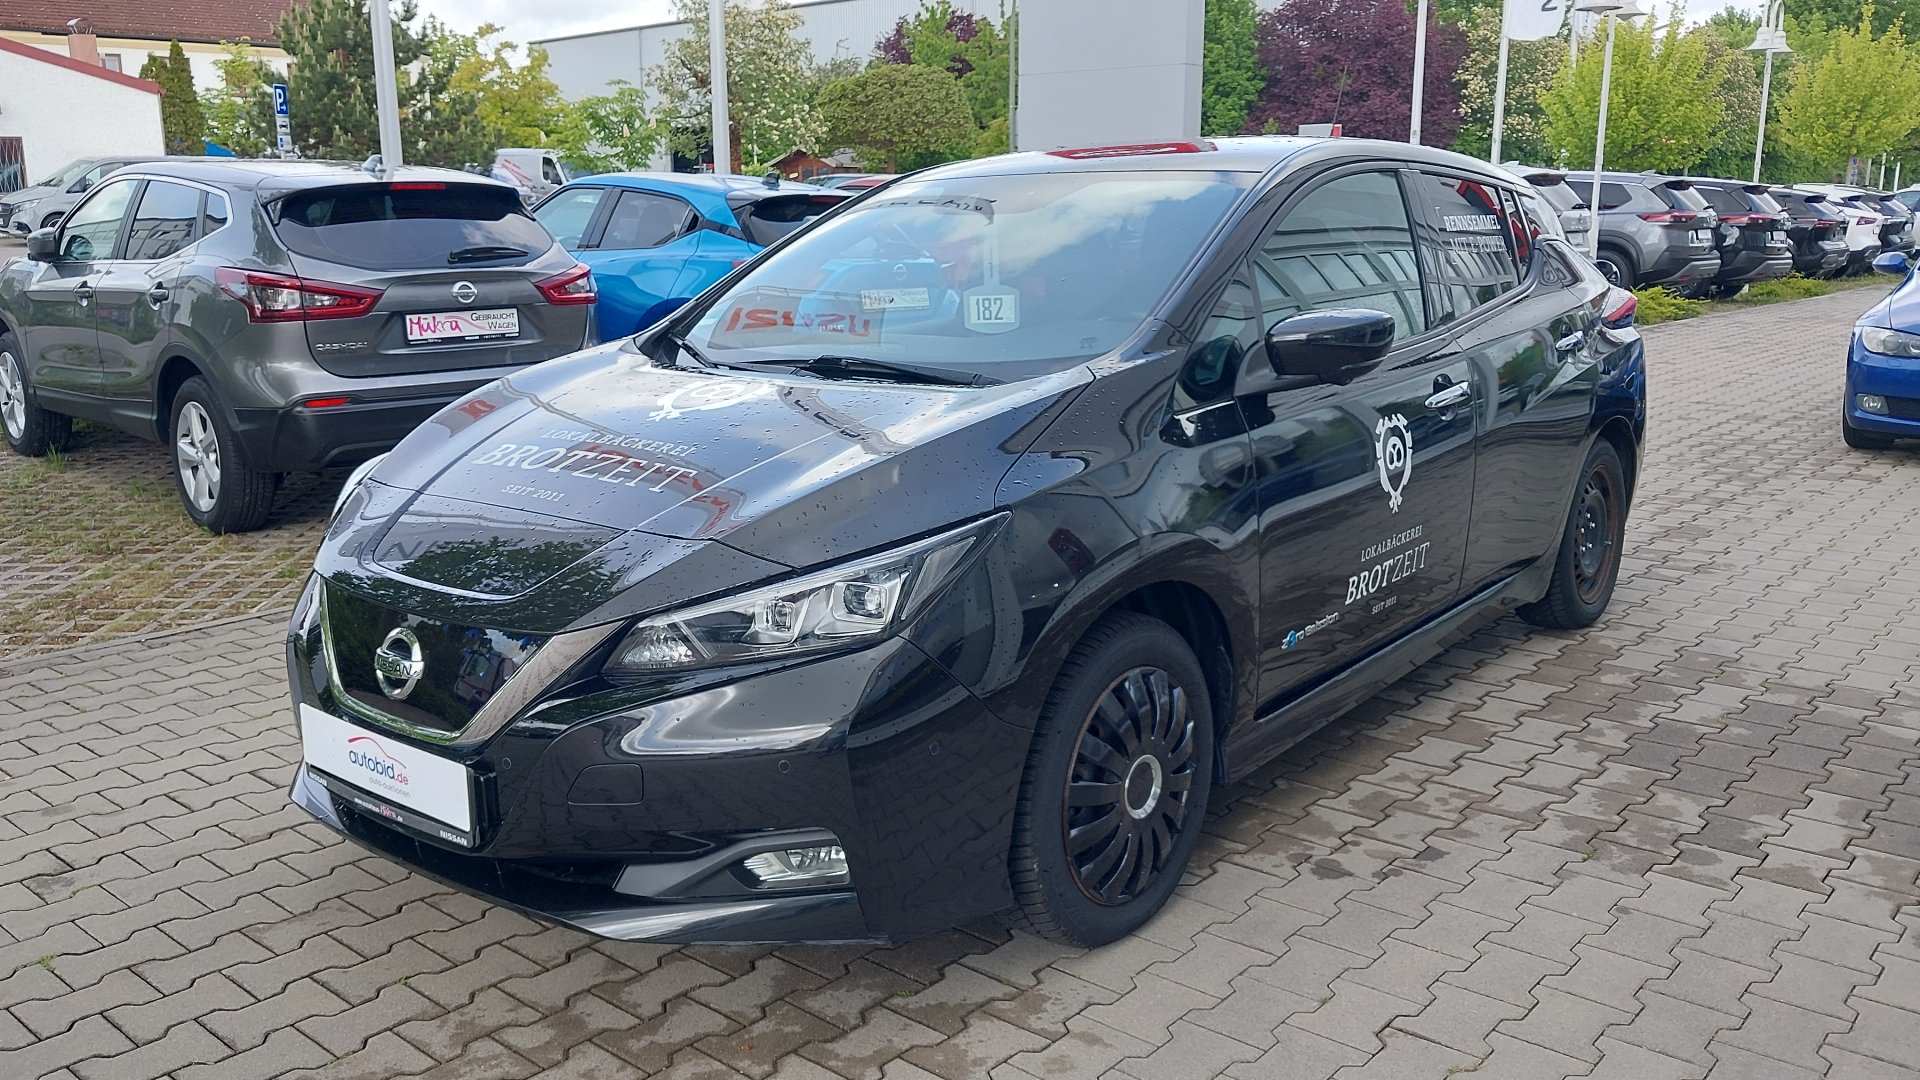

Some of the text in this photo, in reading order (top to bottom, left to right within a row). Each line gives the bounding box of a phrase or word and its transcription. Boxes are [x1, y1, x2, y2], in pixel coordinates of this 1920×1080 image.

[275, 88, 284, 112] P
[1443, 214, 1502, 232] RENNSEMMEL
[470, 312, 515, 322] GEBRAUCHT
[976, 297, 1004, 321] 182
[487, 320, 517, 330] WAGEN
[541, 429, 697, 457] LOKALBÄCKEREI
[470, 443, 698, 493] BROTZEIT
[501, 483, 567, 502] SEIT 2011
[1360, 524, 1423, 562] LOKALBÄCKEREI
[1345, 541, 1431, 606] BROTZEIT
[1371, 602, 1385, 615] SEIT
[377, 654, 413, 677] NISSAN
[349, 749, 409, 786] autobid.de
[439, 829, 468, 847] NISSAN
